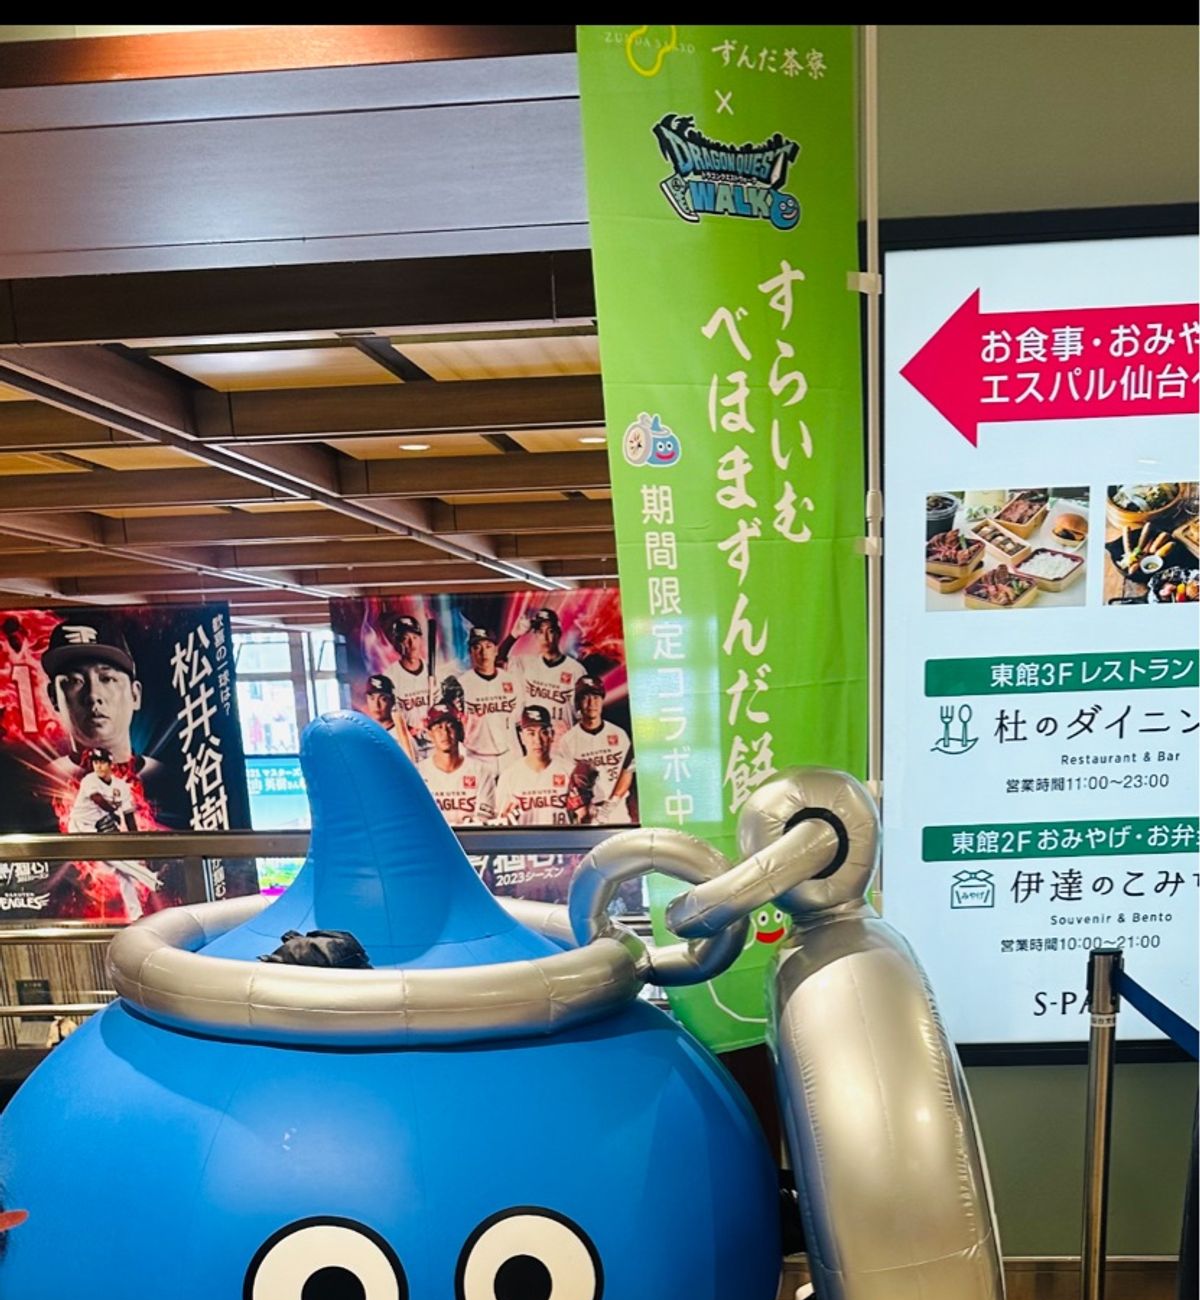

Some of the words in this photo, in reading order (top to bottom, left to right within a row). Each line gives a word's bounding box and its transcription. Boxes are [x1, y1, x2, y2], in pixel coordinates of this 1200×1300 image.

[711, 39, 827, 79] ずんだ茶寮
[688, 180, 771, 219] WALK
[758, 260, 814, 542] すらいむ
[980, 363, 1199, 404] エスパル仙台
[640, 485, 694, 826] 期間限定コラボ中
[12, 665, 39, 733] 1
[465, 698, 517, 717] EAGLES
[526, 680, 575, 704] EAGLES
[170, 624, 230, 830] 松井裕樹
[1061, 753, 1137, 765] Restaurant
[1143, 752, 1150, 762] &
[1158, 751, 1180, 762] Bar
[1010, 868, 1199, 904] 伊達のこみ
[1050, 913, 1112, 926] Souvenir
[1118, 912, 1126, 923] &
[1132, 912, 1173, 923] Bento
